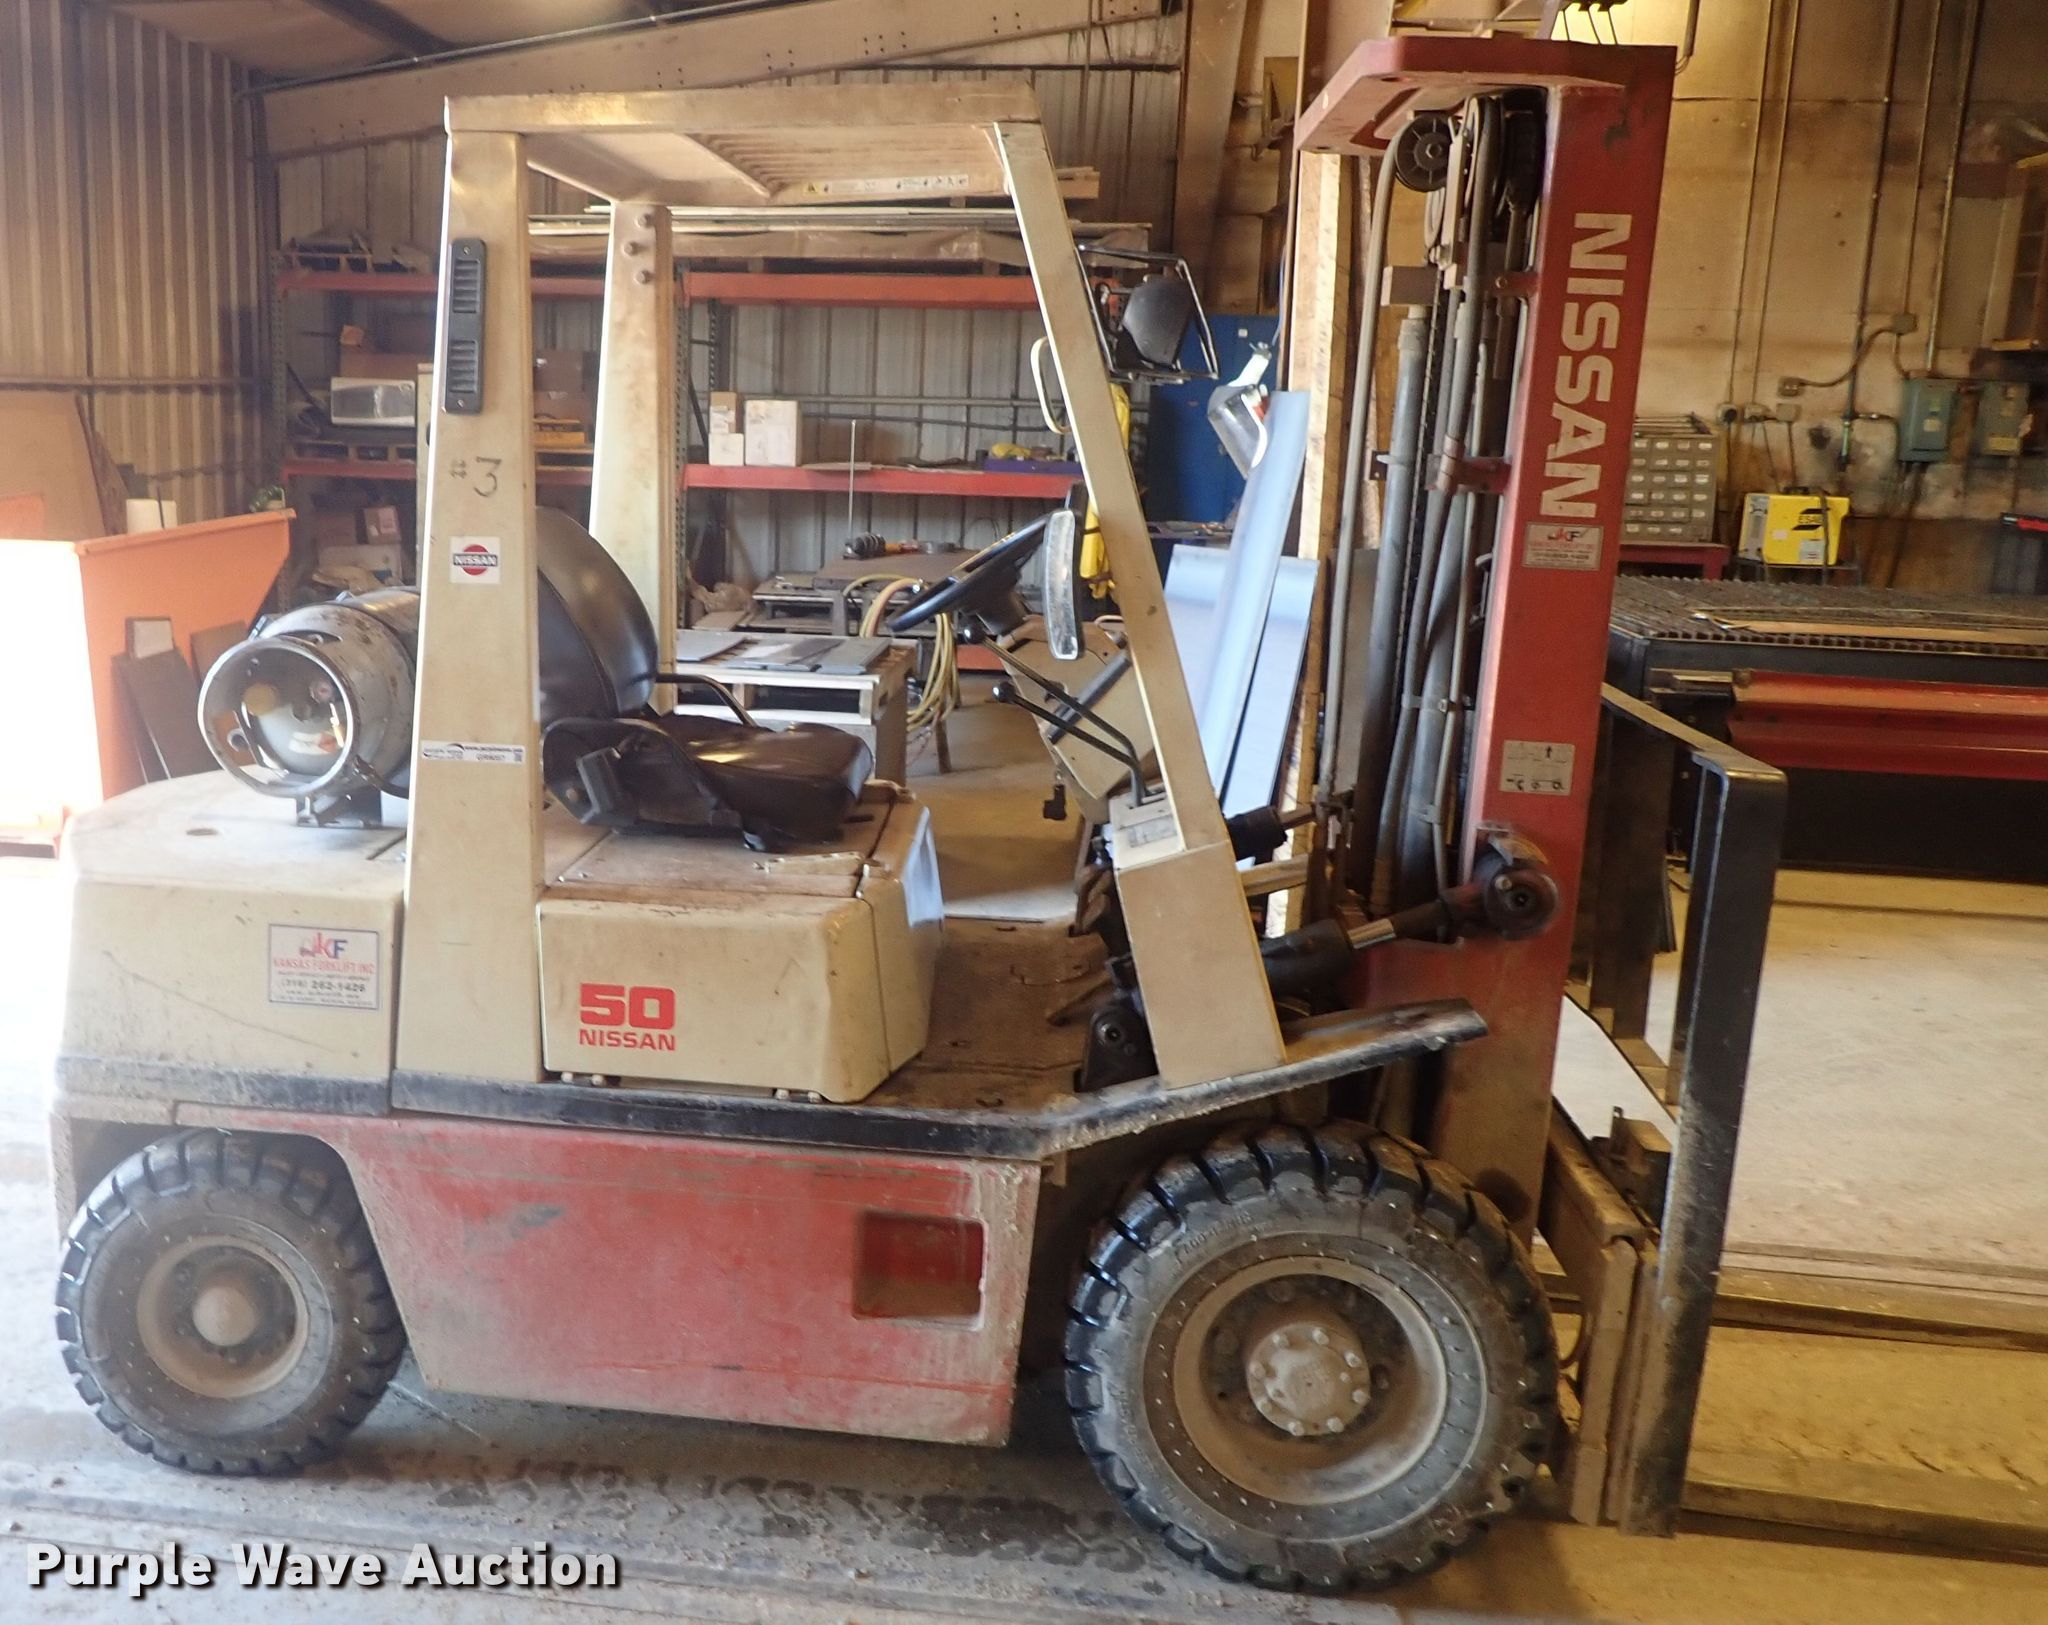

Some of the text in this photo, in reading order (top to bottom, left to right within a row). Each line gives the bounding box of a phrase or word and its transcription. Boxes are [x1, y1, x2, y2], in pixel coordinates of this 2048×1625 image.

[1540, 213, 1632, 518] NISSAN
[454, 554, 497, 566] NISSAN
[580, 983, 675, 1030] 50
[579, 1029, 675, 1051] NISSAN
